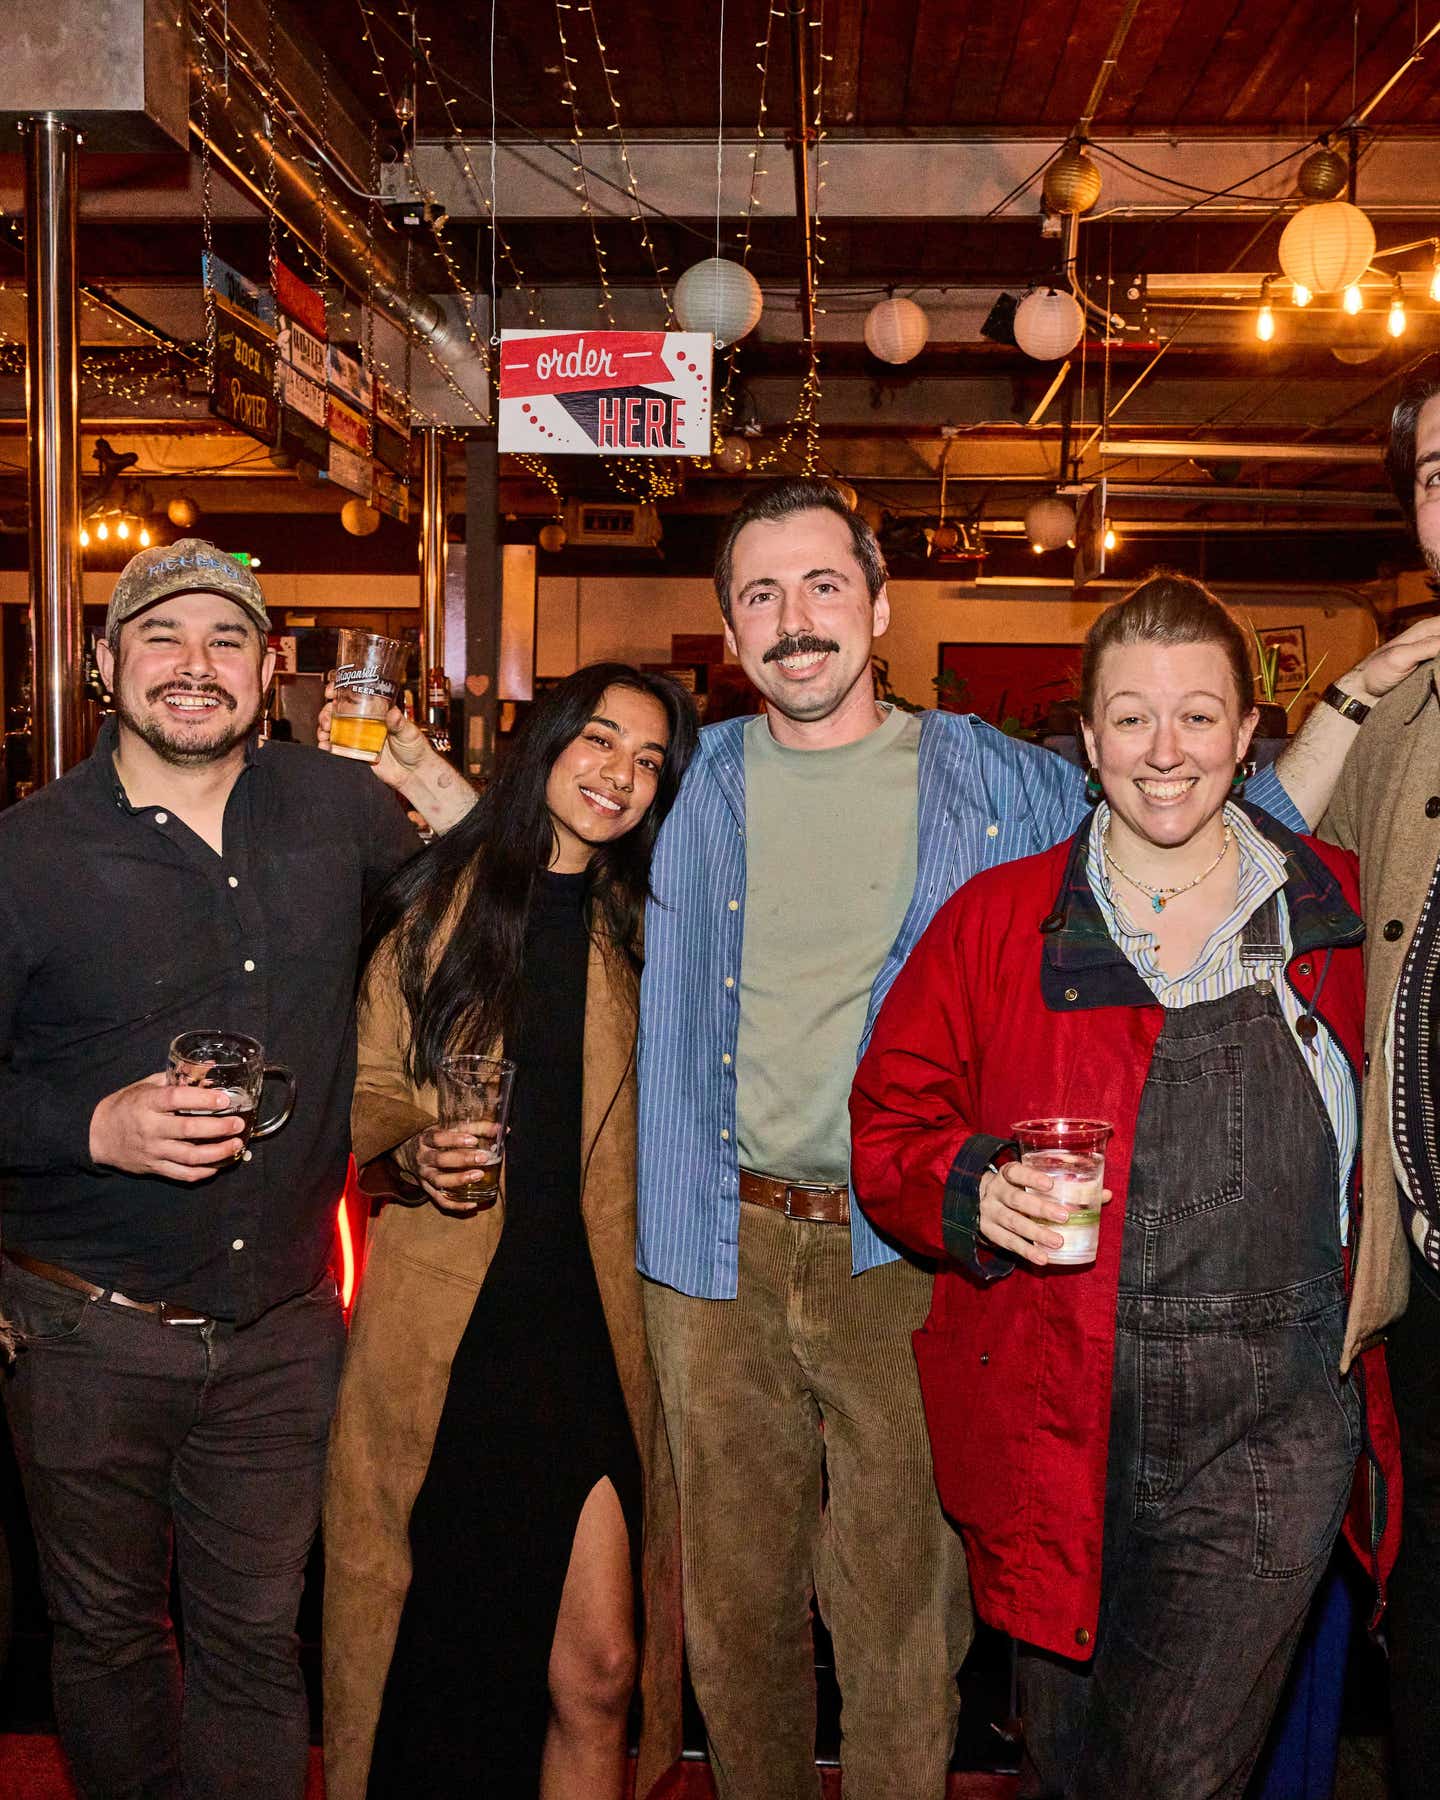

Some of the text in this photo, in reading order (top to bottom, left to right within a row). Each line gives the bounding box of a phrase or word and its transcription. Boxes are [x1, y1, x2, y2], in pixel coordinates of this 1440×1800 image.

[234, 335, 261, 374] BOCK
[536, 338, 618, 380] order
[231, 377, 268, 430] PORTER
[598, 397, 686, 449] HERE
[352, 685, 375, 695] BEER
